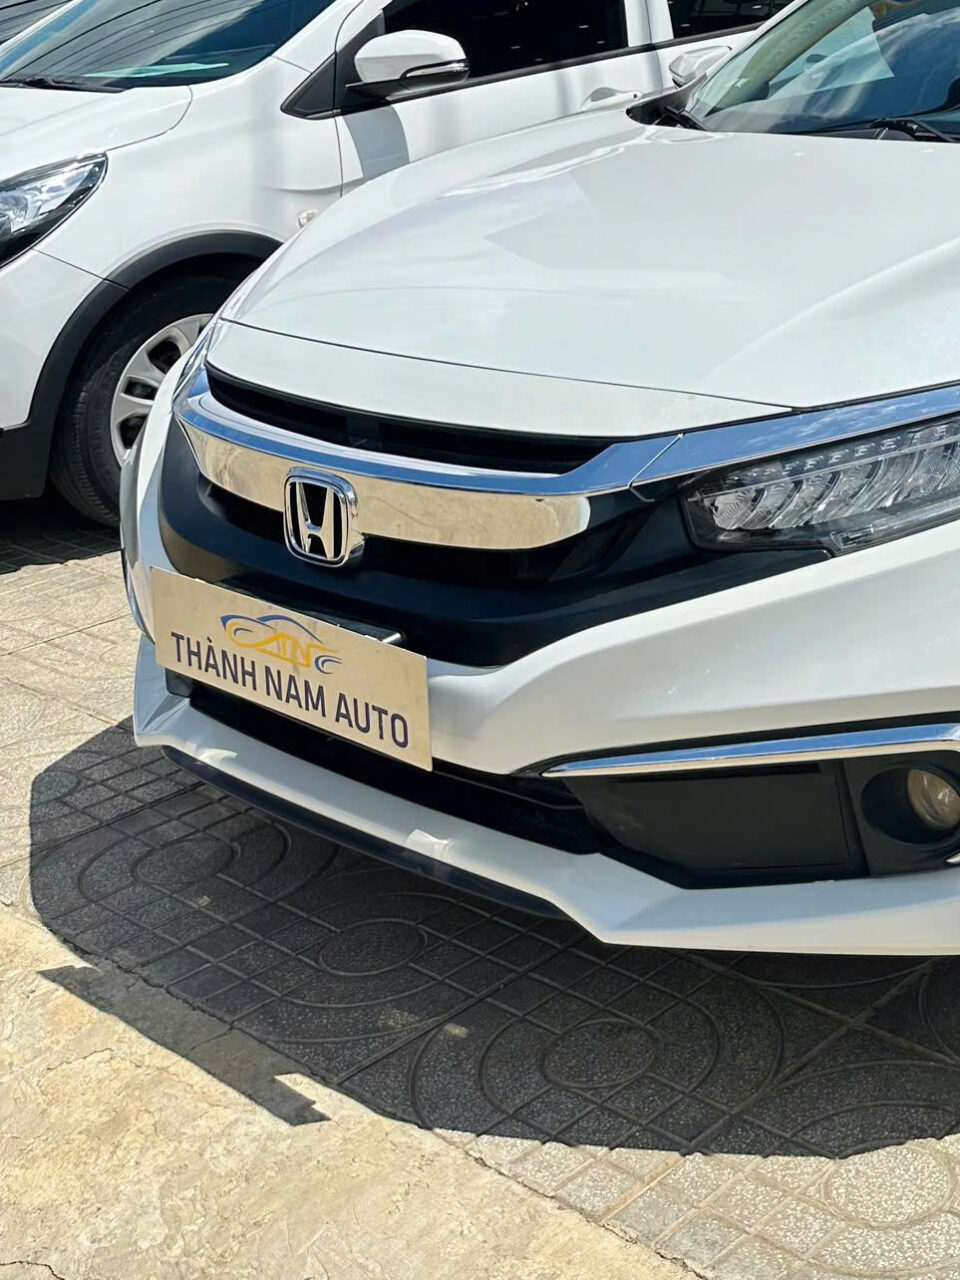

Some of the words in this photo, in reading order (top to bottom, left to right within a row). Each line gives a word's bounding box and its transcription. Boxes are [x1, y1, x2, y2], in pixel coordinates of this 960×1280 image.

[171, 632, 257, 692] THÀNH
[265, 665, 327, 718] NAM
[335, 692, 409, 749] AUTO
